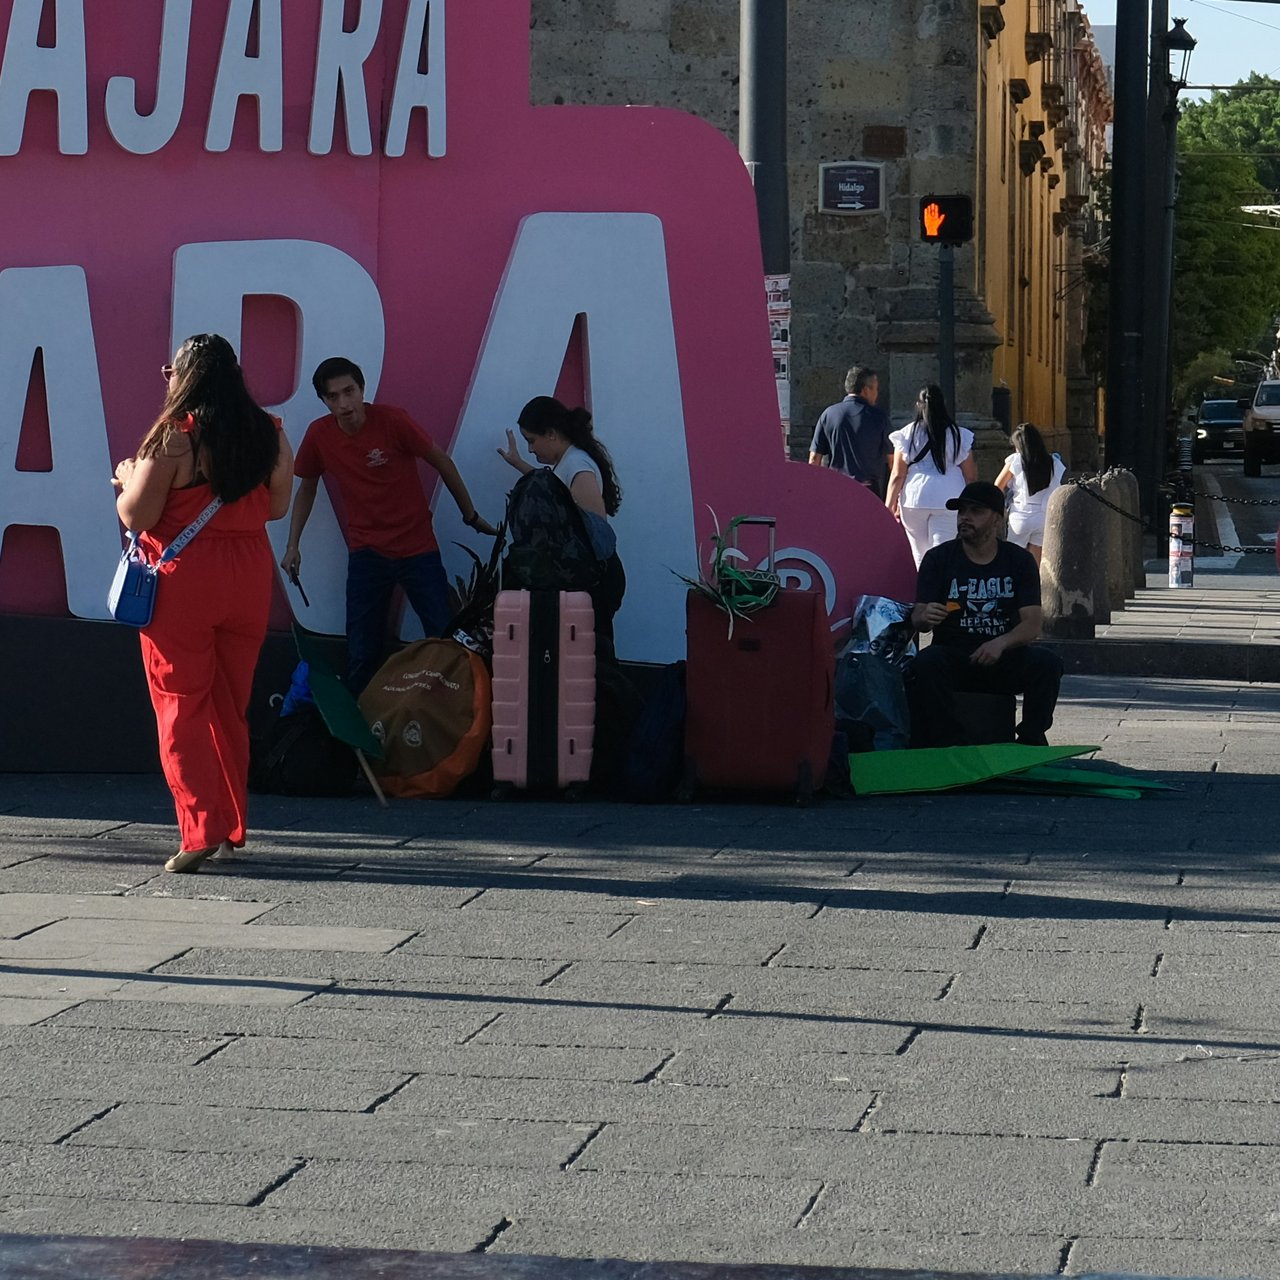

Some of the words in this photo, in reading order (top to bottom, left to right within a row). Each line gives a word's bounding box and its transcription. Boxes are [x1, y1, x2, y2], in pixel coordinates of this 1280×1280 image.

[838, 182, 865, 194] Hidalgo
[947, 576, 1015, 599] A-EAGLE
[959, 616, 1011, 627] HERITA
